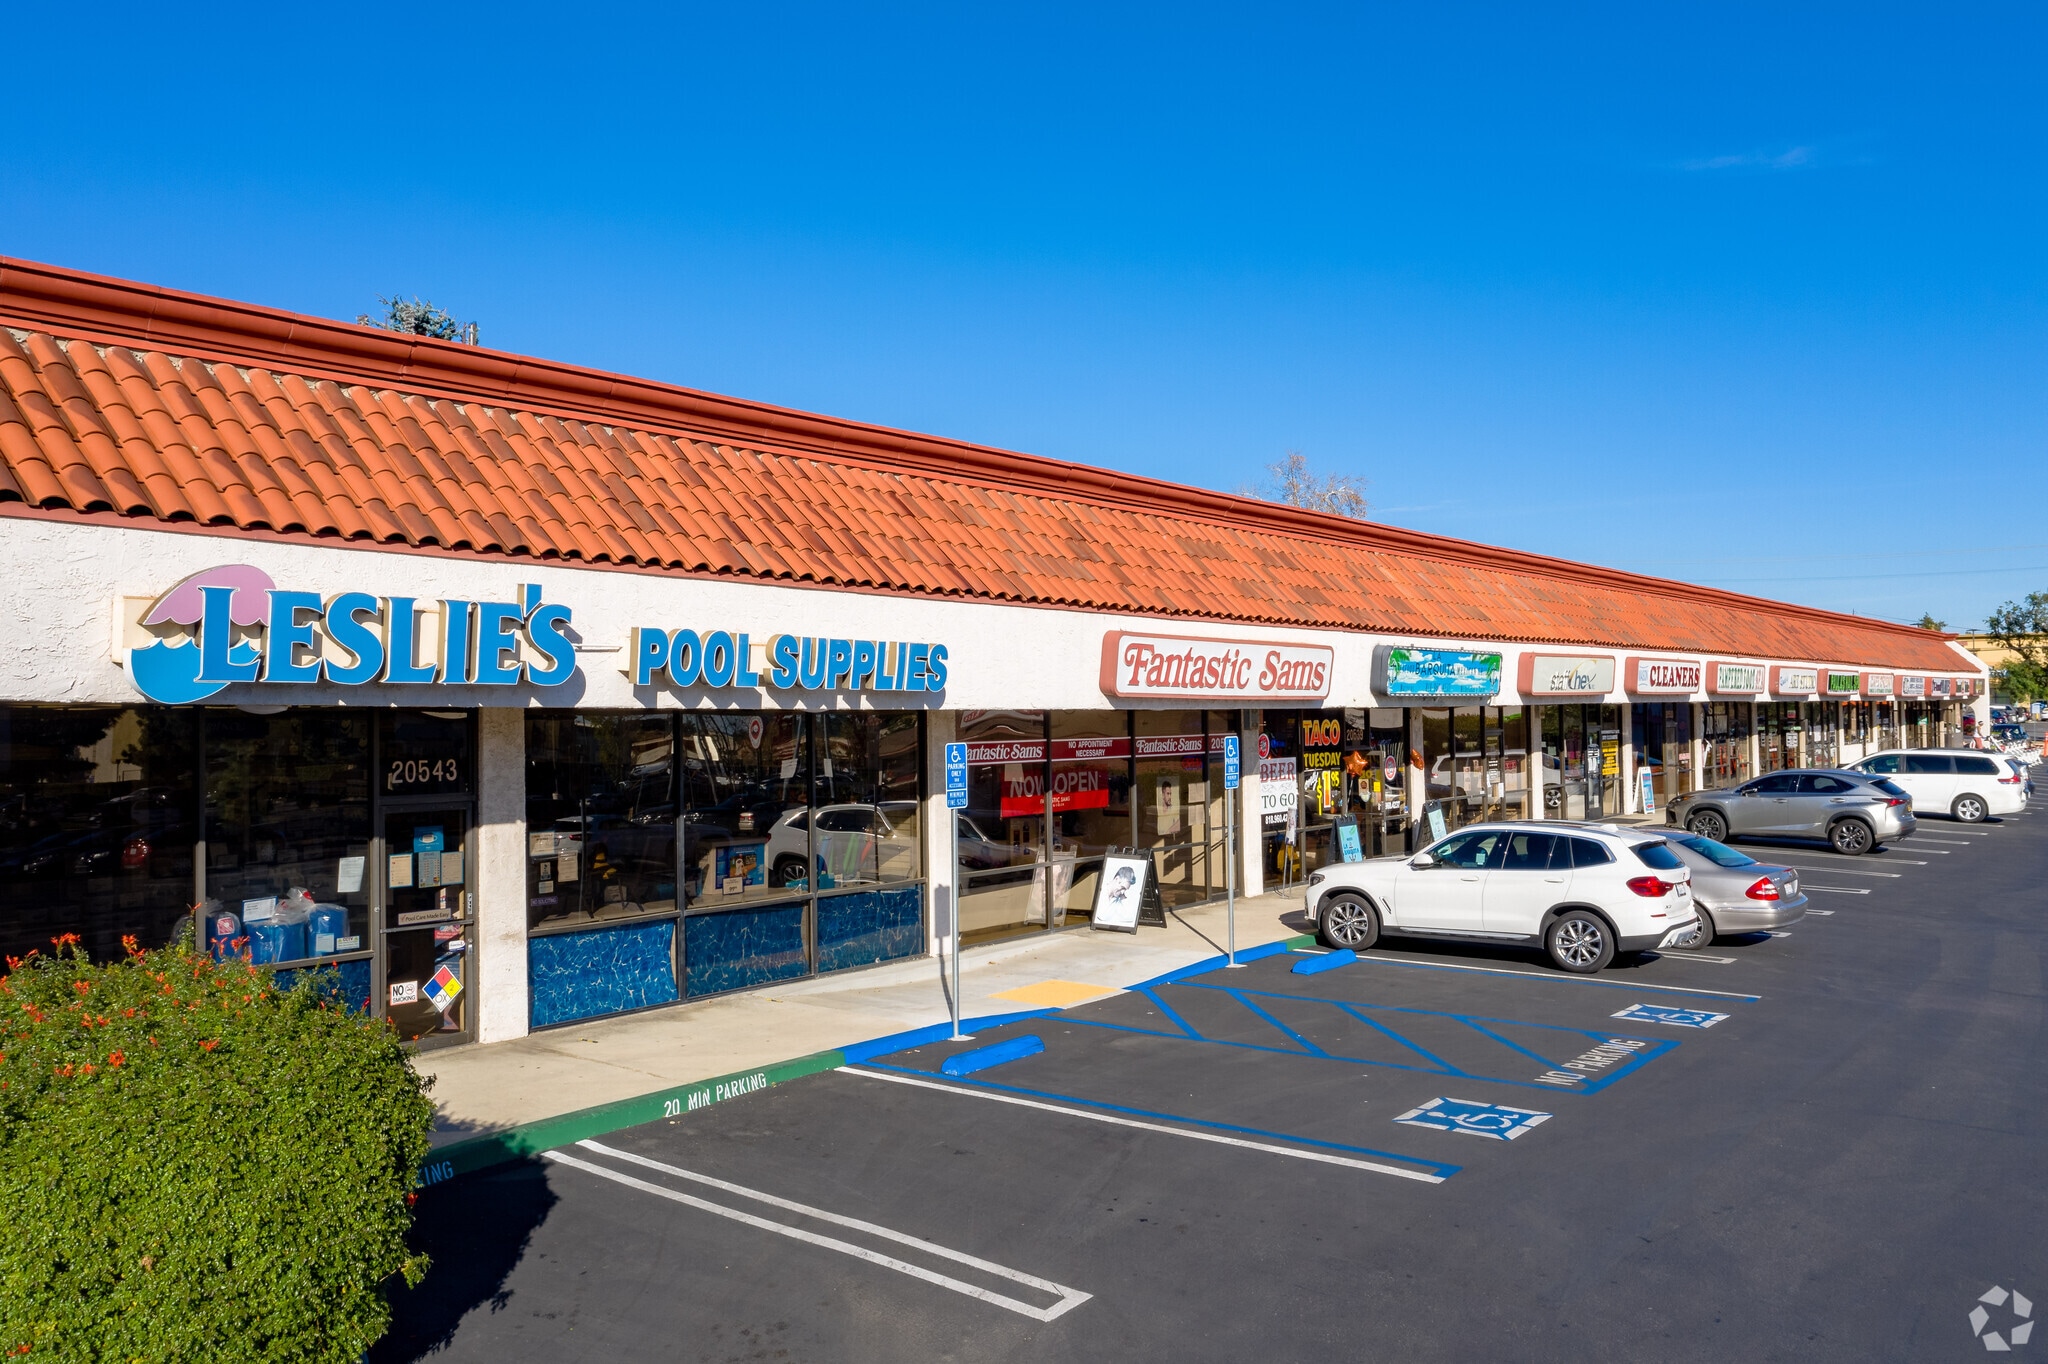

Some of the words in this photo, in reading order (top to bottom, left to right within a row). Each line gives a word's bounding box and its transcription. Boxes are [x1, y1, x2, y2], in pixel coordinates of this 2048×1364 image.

[193, 583, 577, 686] LESLIE'S
[635, 627, 759, 687] POOL
[769, 634, 949, 692] SUPPLIES
[1124, 642, 1252, 689] Fantastic
[1258, 650, 1327, 691] Sams
[1415, 662, 1456, 676] BARQUITA
[1650, 666, 1700, 687] CLEANERS
[1302, 719, 1341, 746] TACO
[967, 743, 1010, 761] antastic
[1011, 743, 1043, 760] Sams
[1068, 741, 1076, 749] NO
[1077, 740, 1113, 748] APPOINTMENT
[1075, 749, 1105, 757] NECESSARY
[1136, 739, 1178, 753] Fantastic
[1178, 738, 1202, 751] Sams
[1303, 752, 1341, 767] TUESDAY
[391, 759, 457, 783] 20543
[1260, 761, 1295, 783] BEER
[1010, 775, 1044, 798] NOW
[1054, 771, 1099, 793] OPEN
[1261, 794, 1277, 809] TO
[1280, 792, 1295, 806] GO
[1264, 813, 1288, 825] 818.960.42
[392, 985, 404, 996] NO
[435, 993, 447, 1003] OX
[1534, 1070, 1586, 1086] NO
[1561, 1038, 1646, 1072] PARKING
[663, 1098, 680, 1118] 20
[688, 1088, 711, 1111] MIN
[716, 1073, 766, 1102] PARKING
